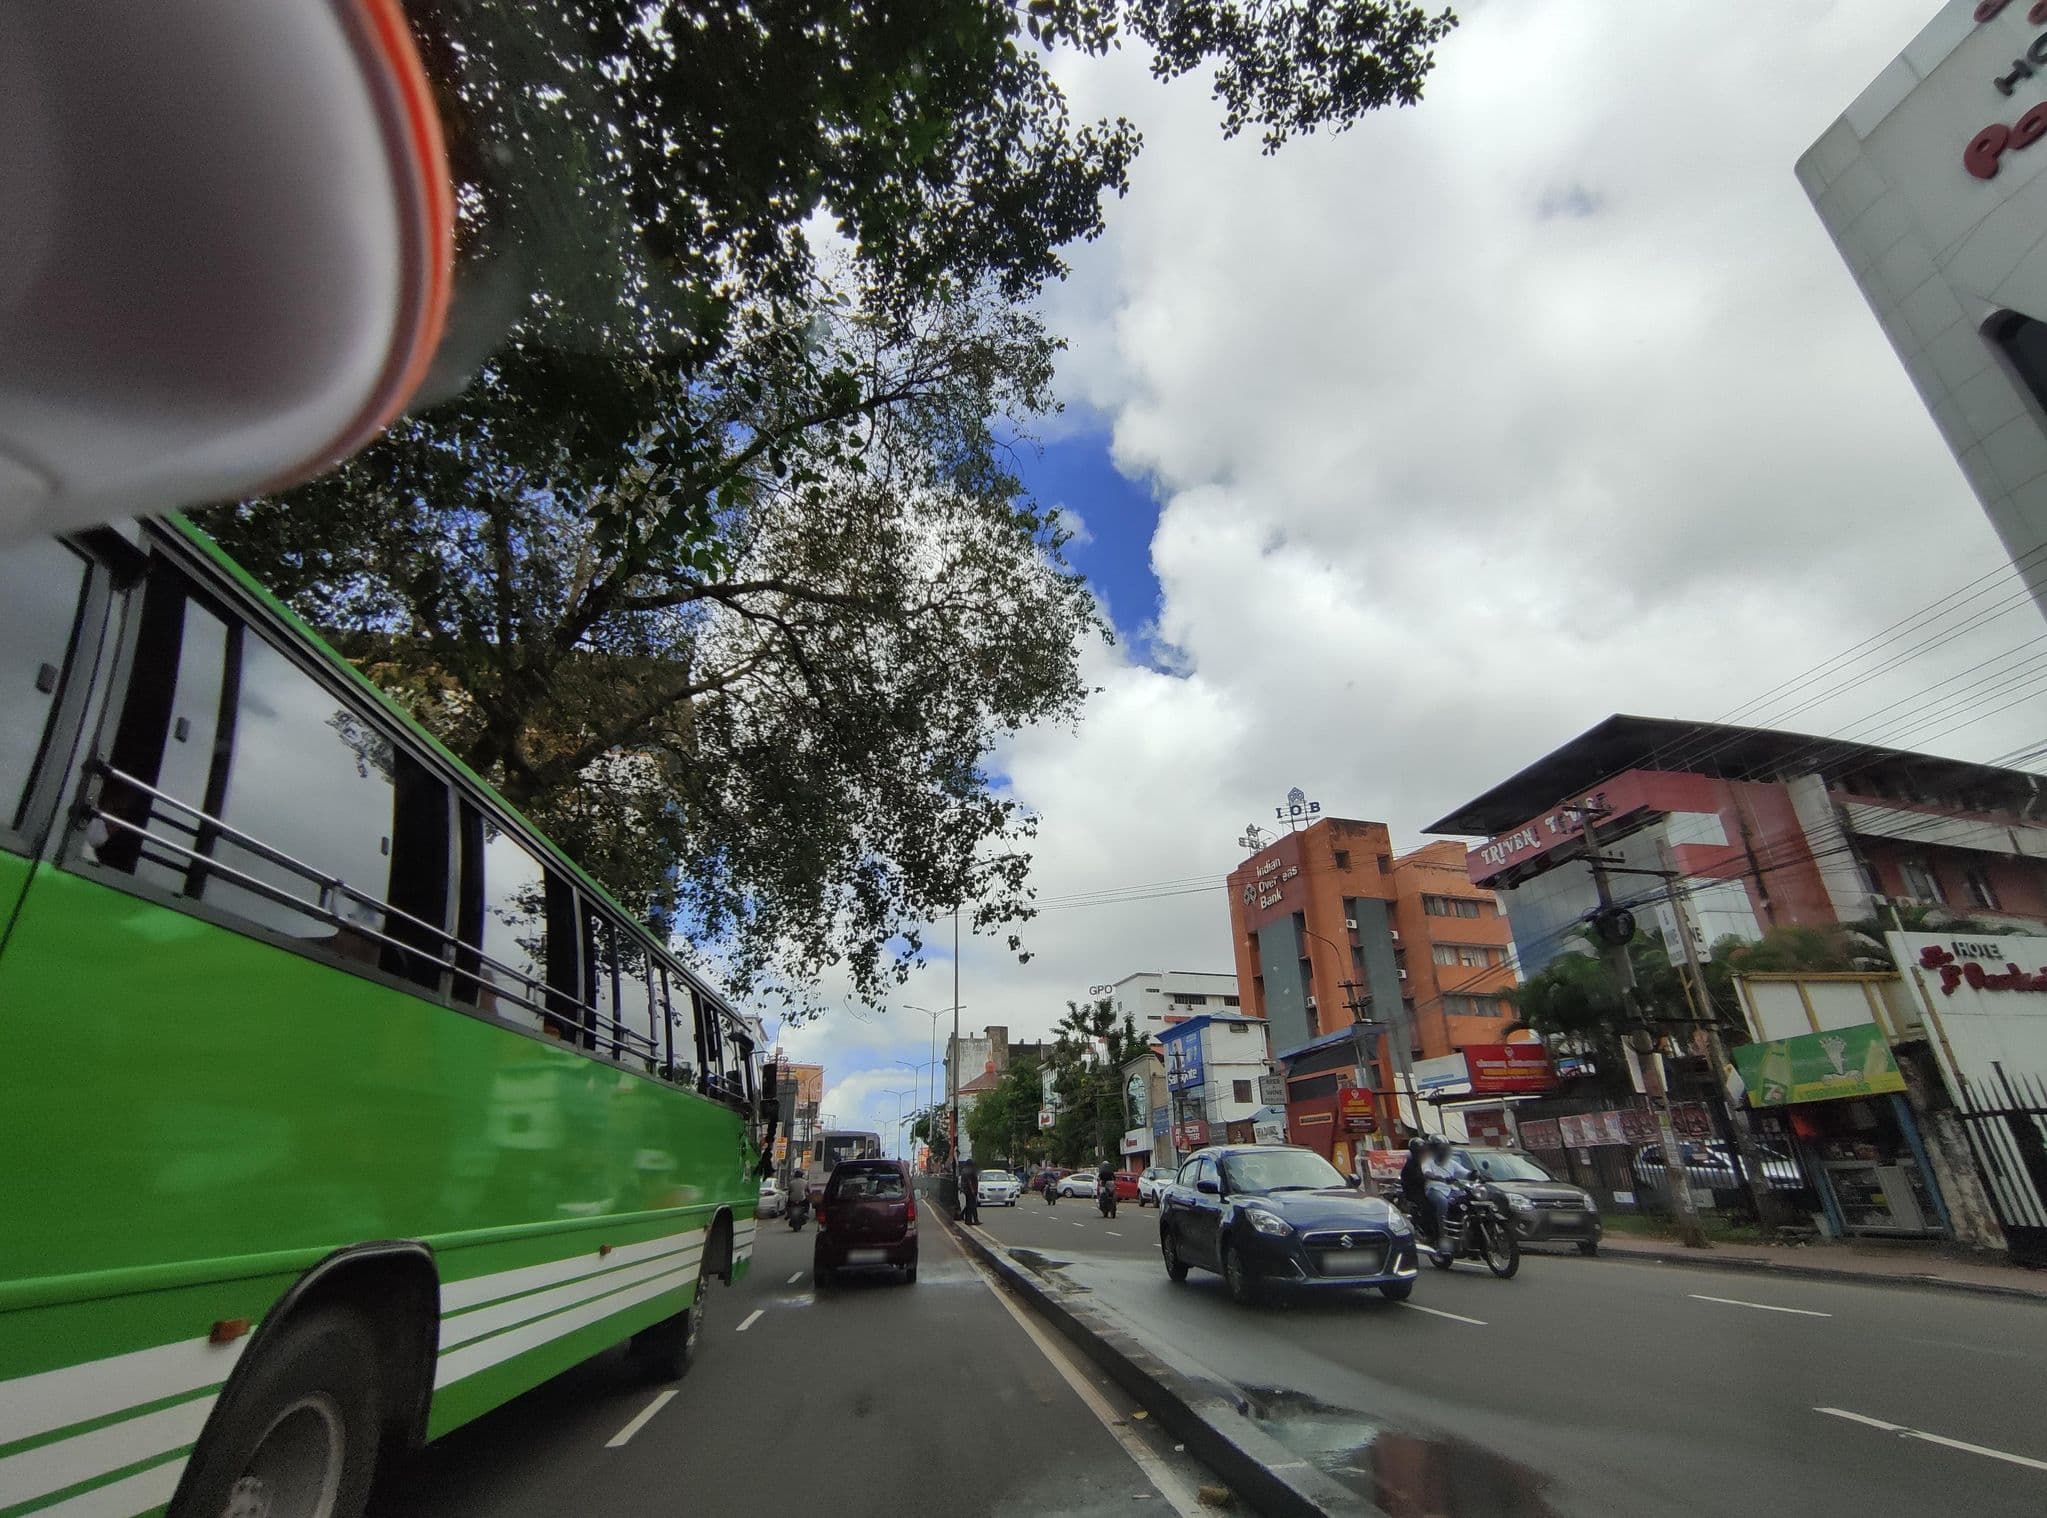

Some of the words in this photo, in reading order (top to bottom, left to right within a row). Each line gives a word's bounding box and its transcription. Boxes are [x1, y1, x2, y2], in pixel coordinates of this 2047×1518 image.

[1256, 858, 1281, 879] Indian
[1260, 888, 1283, 909] Bank
[1089, 984, 1113, 996] GPO
